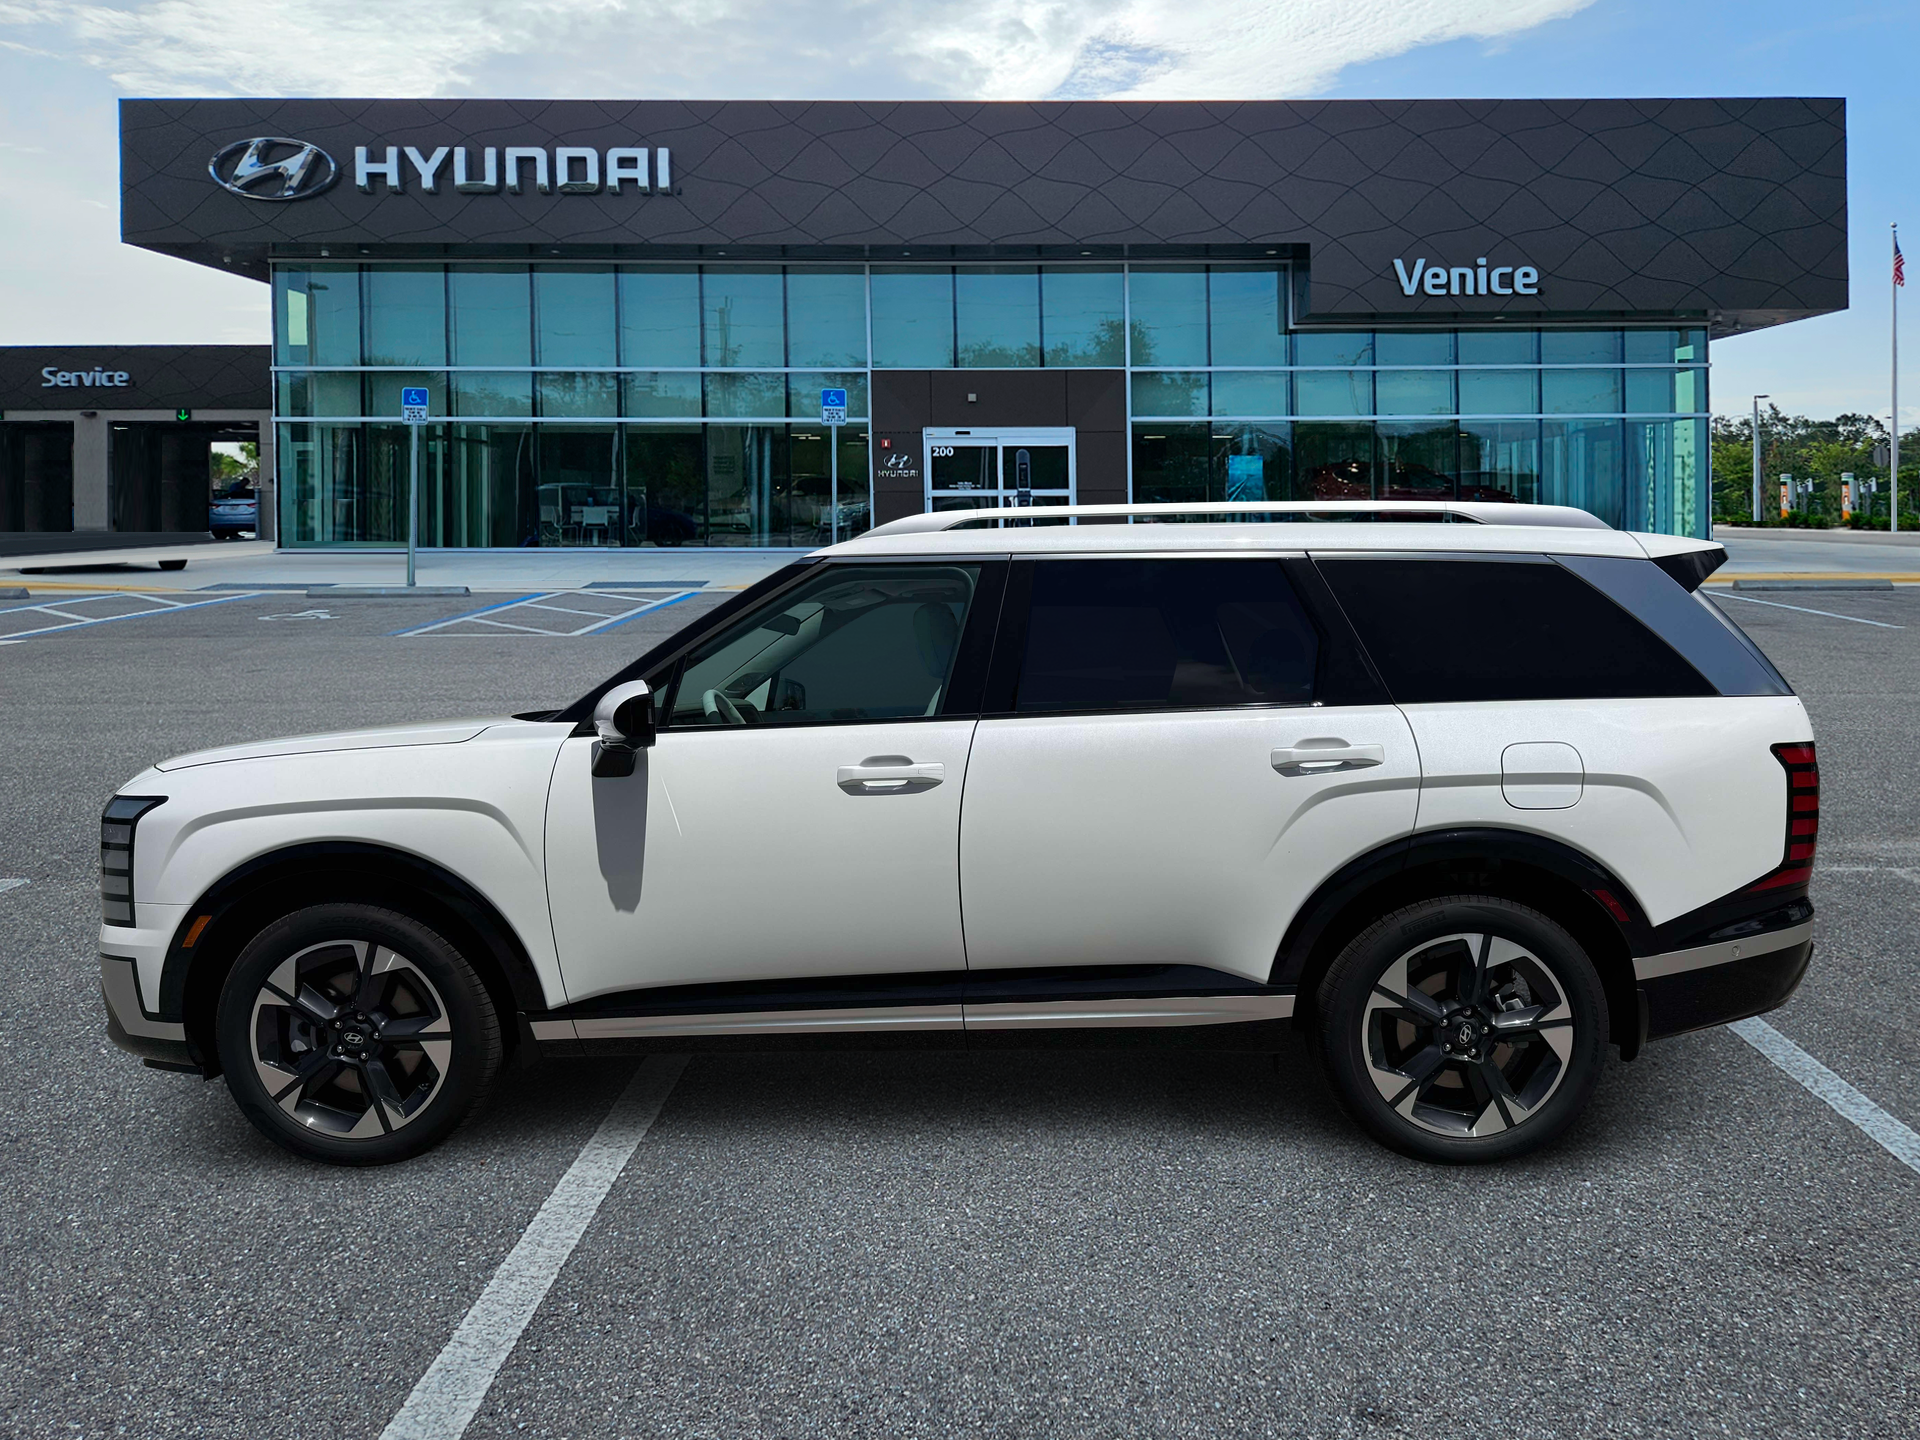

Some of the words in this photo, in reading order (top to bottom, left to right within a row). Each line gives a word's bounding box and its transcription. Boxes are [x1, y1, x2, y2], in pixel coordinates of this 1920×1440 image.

[354, 146, 671, 195] HYUNDAI
[1392, 257, 1539, 296] Venice
[41, 366, 130, 388] Service
[932, 446, 954, 457] 200
[877, 469, 919, 478] HYUNDAI
[1399, 910, 1447, 936] PIRELLI
